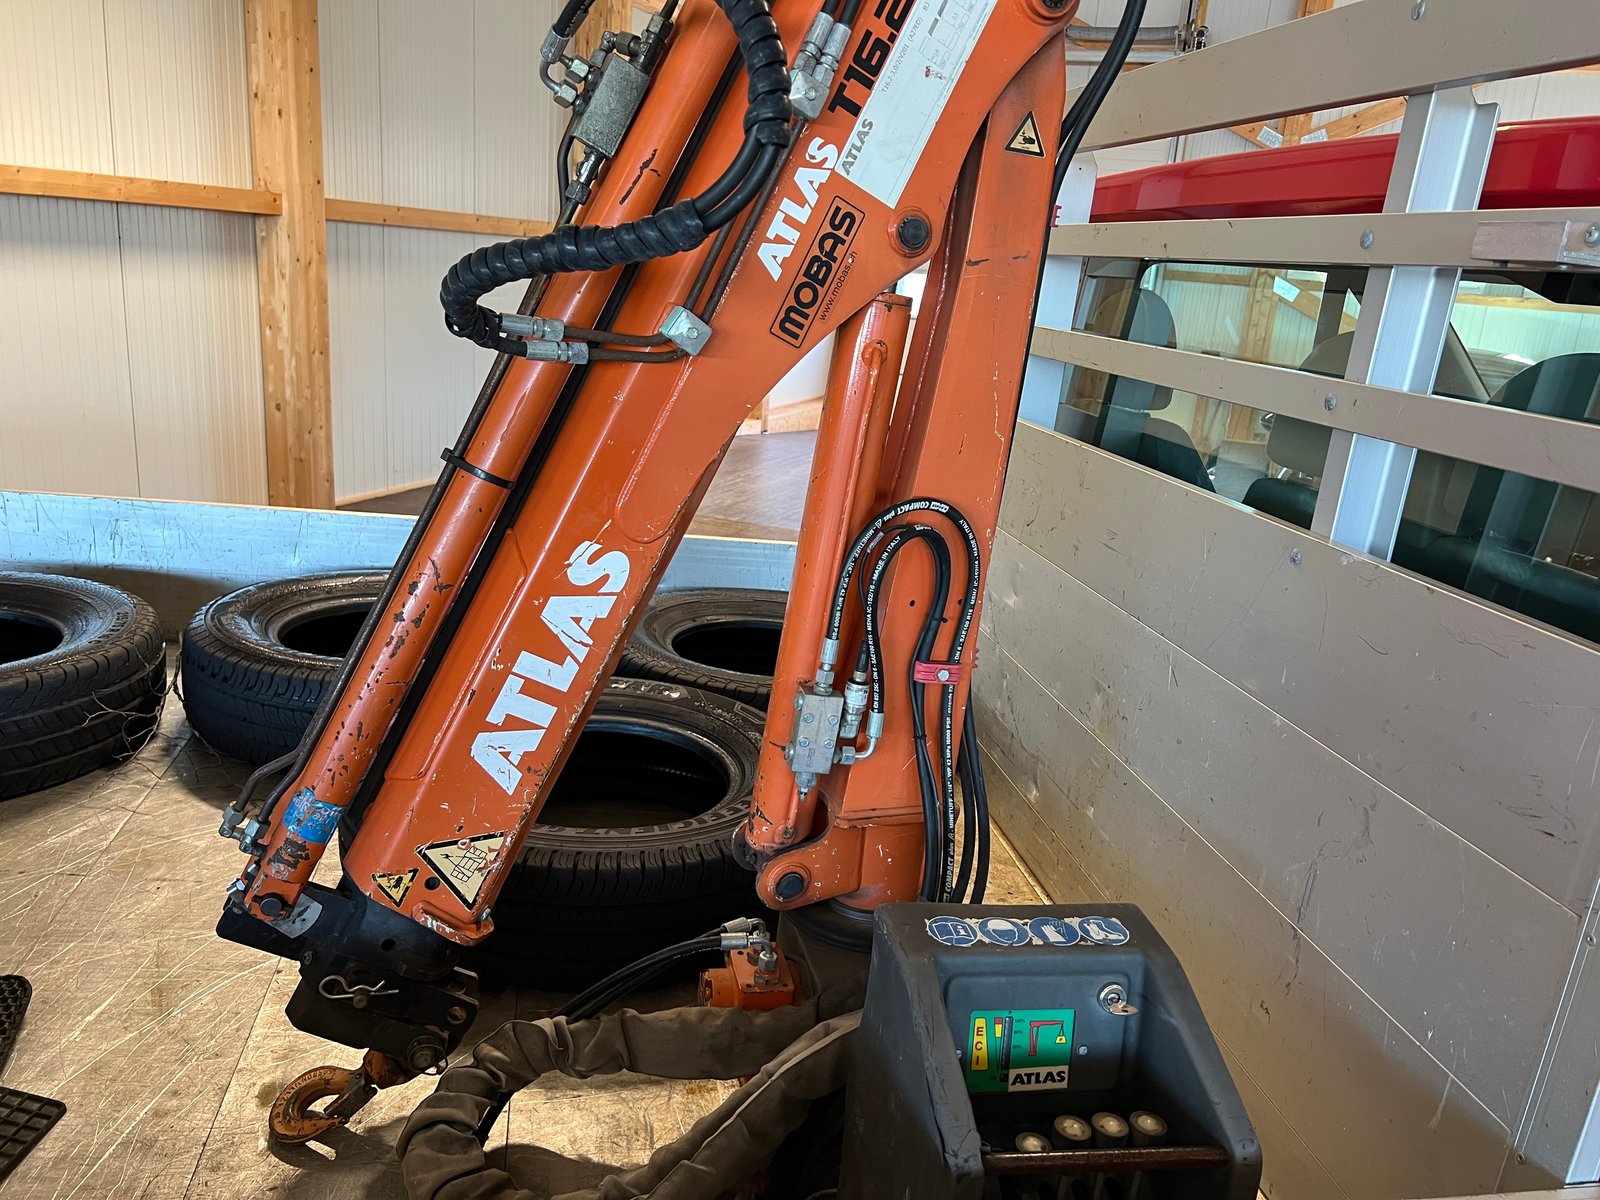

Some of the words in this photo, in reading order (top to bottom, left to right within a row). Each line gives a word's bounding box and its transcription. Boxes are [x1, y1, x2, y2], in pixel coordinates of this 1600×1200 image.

[842, 118, 874, 175] ATLAS
[757, 136, 839, 282] ATLAS
[895, 500, 929, 515] COMPACT
[958, 518, 971, 533] ITALY
[852, 529, 875, 558] MINETUFF
[871, 559, 885, 580] MADE
[881, 551, 889, 559] IN
[885, 534, 901, 551] ITALY
[970, 538, 978, 556] MADE
[470, 540, 630, 796] ATLAS
[944, 856, 954, 892] COMPACT
[1010, 1071, 1066, 1086] ATLAS
